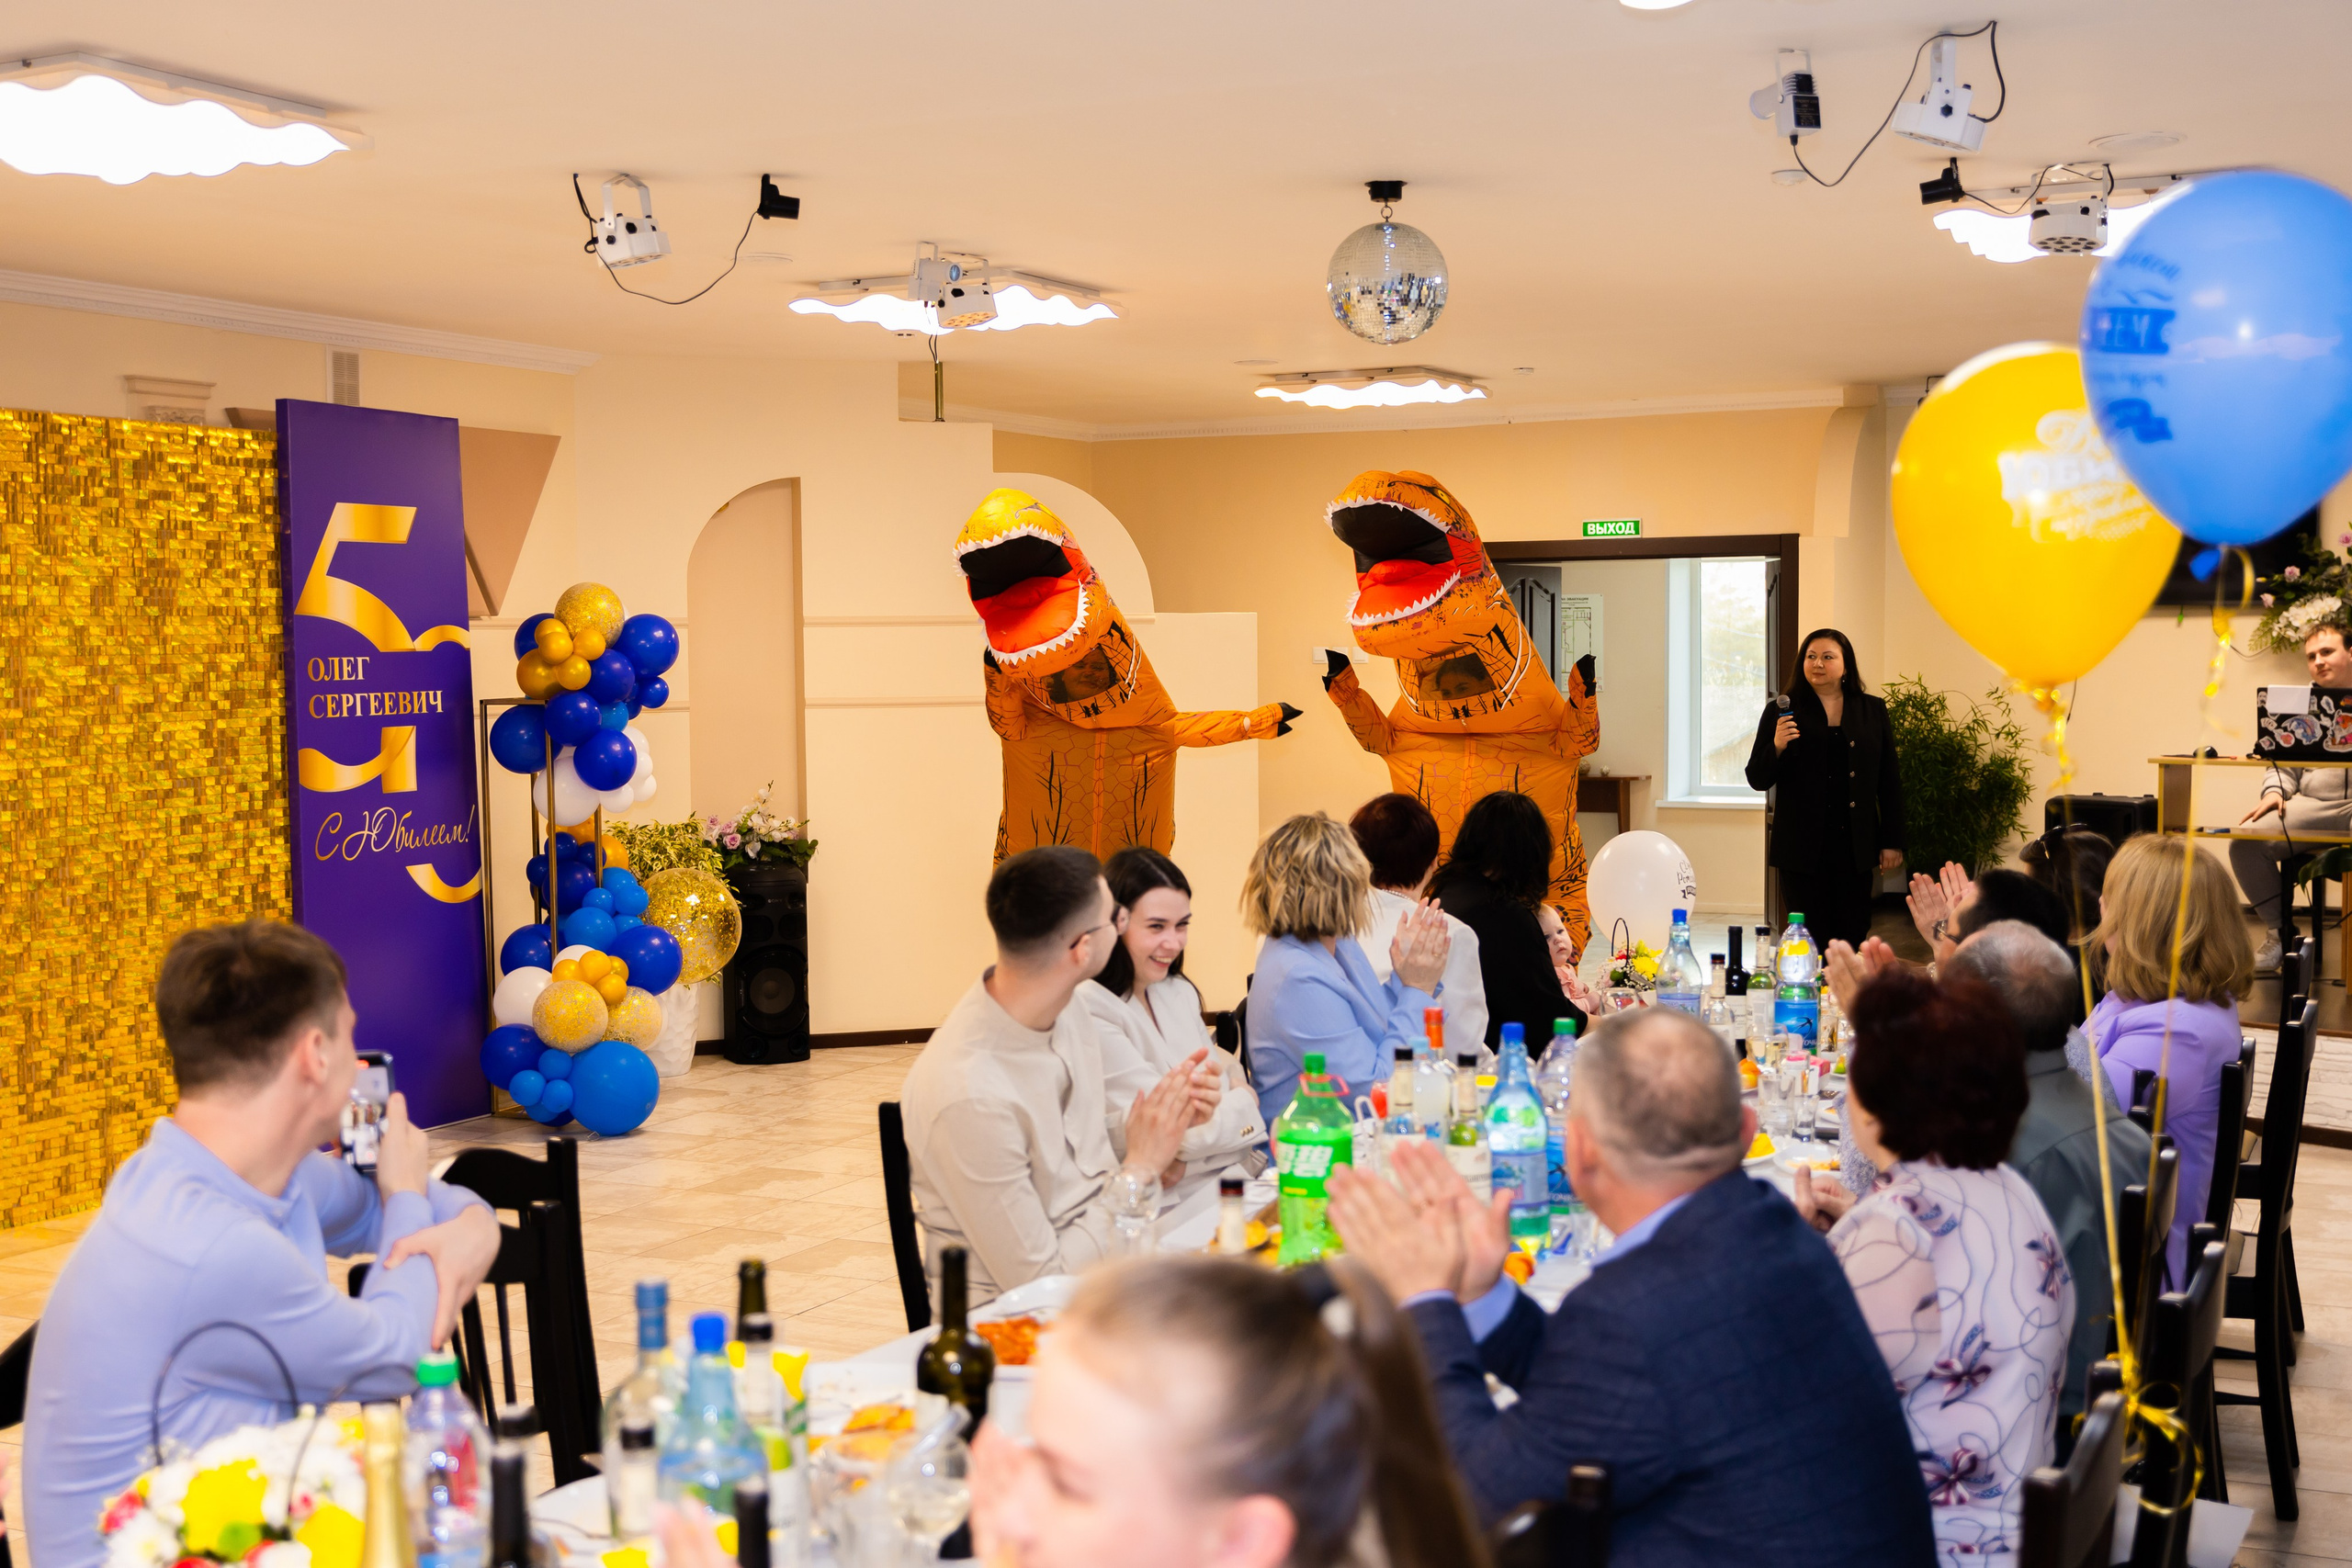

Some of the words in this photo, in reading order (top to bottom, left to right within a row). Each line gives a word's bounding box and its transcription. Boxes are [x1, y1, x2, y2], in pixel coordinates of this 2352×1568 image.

[1587, 522, 1635, 536] ВЫХОД
[307, 656, 370, 682] ОЛЕГ
[309, 690, 444, 719] СЕРГЕЕВИЧ
[314, 811, 343, 862] С
